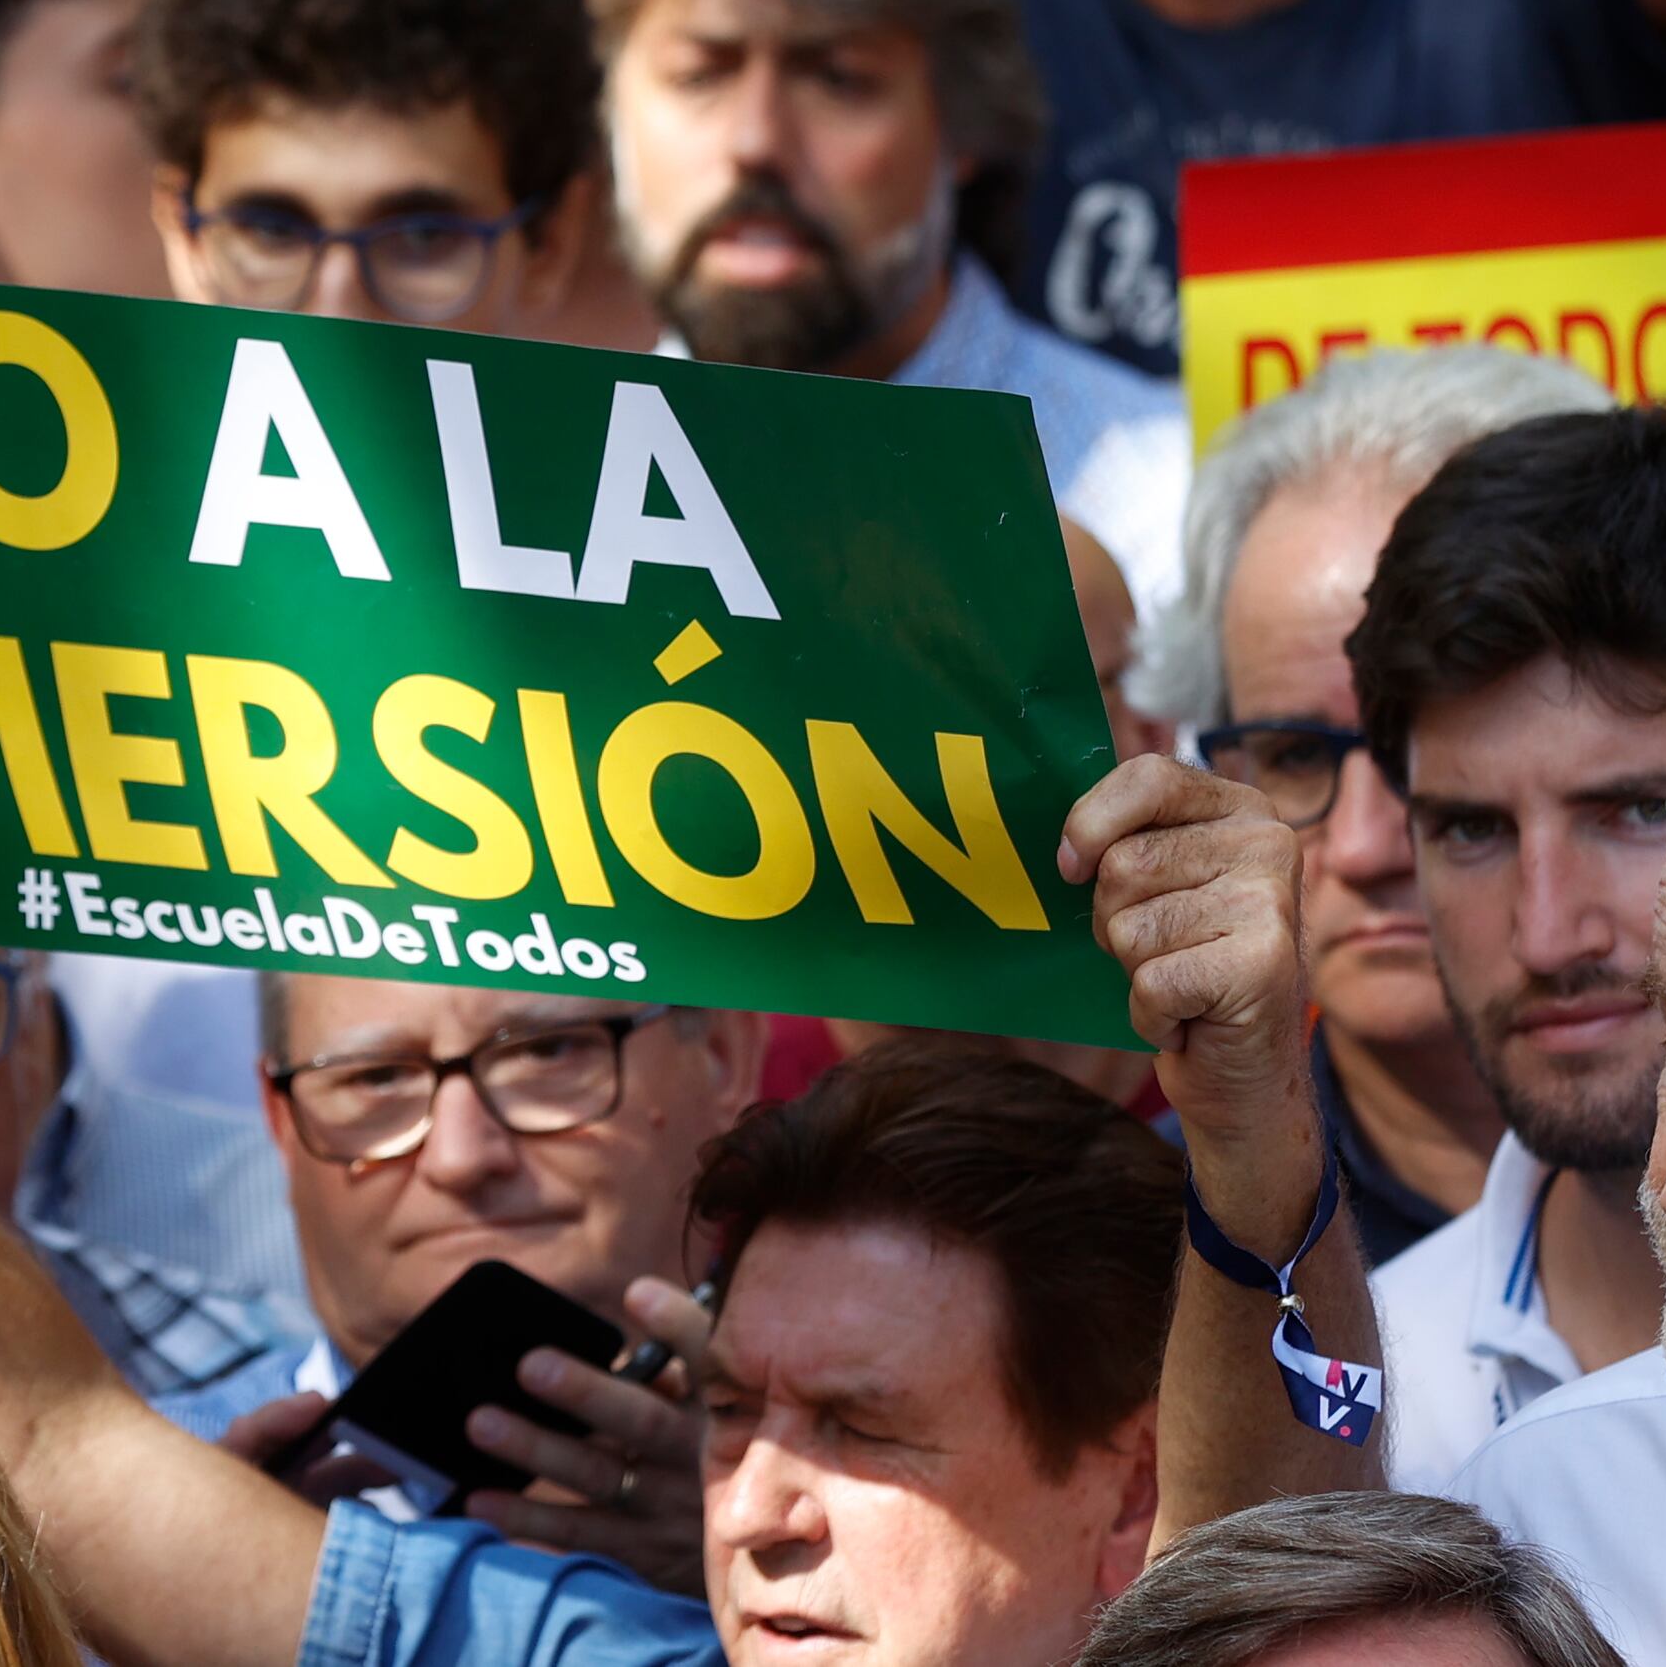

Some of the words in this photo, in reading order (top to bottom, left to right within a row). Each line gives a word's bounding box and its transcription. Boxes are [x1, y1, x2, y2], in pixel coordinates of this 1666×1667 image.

[188, 337, 393, 582] A
[426, 359, 782, 621] LA
[18, 868, 647, 983] #EscuelaDeTodos
